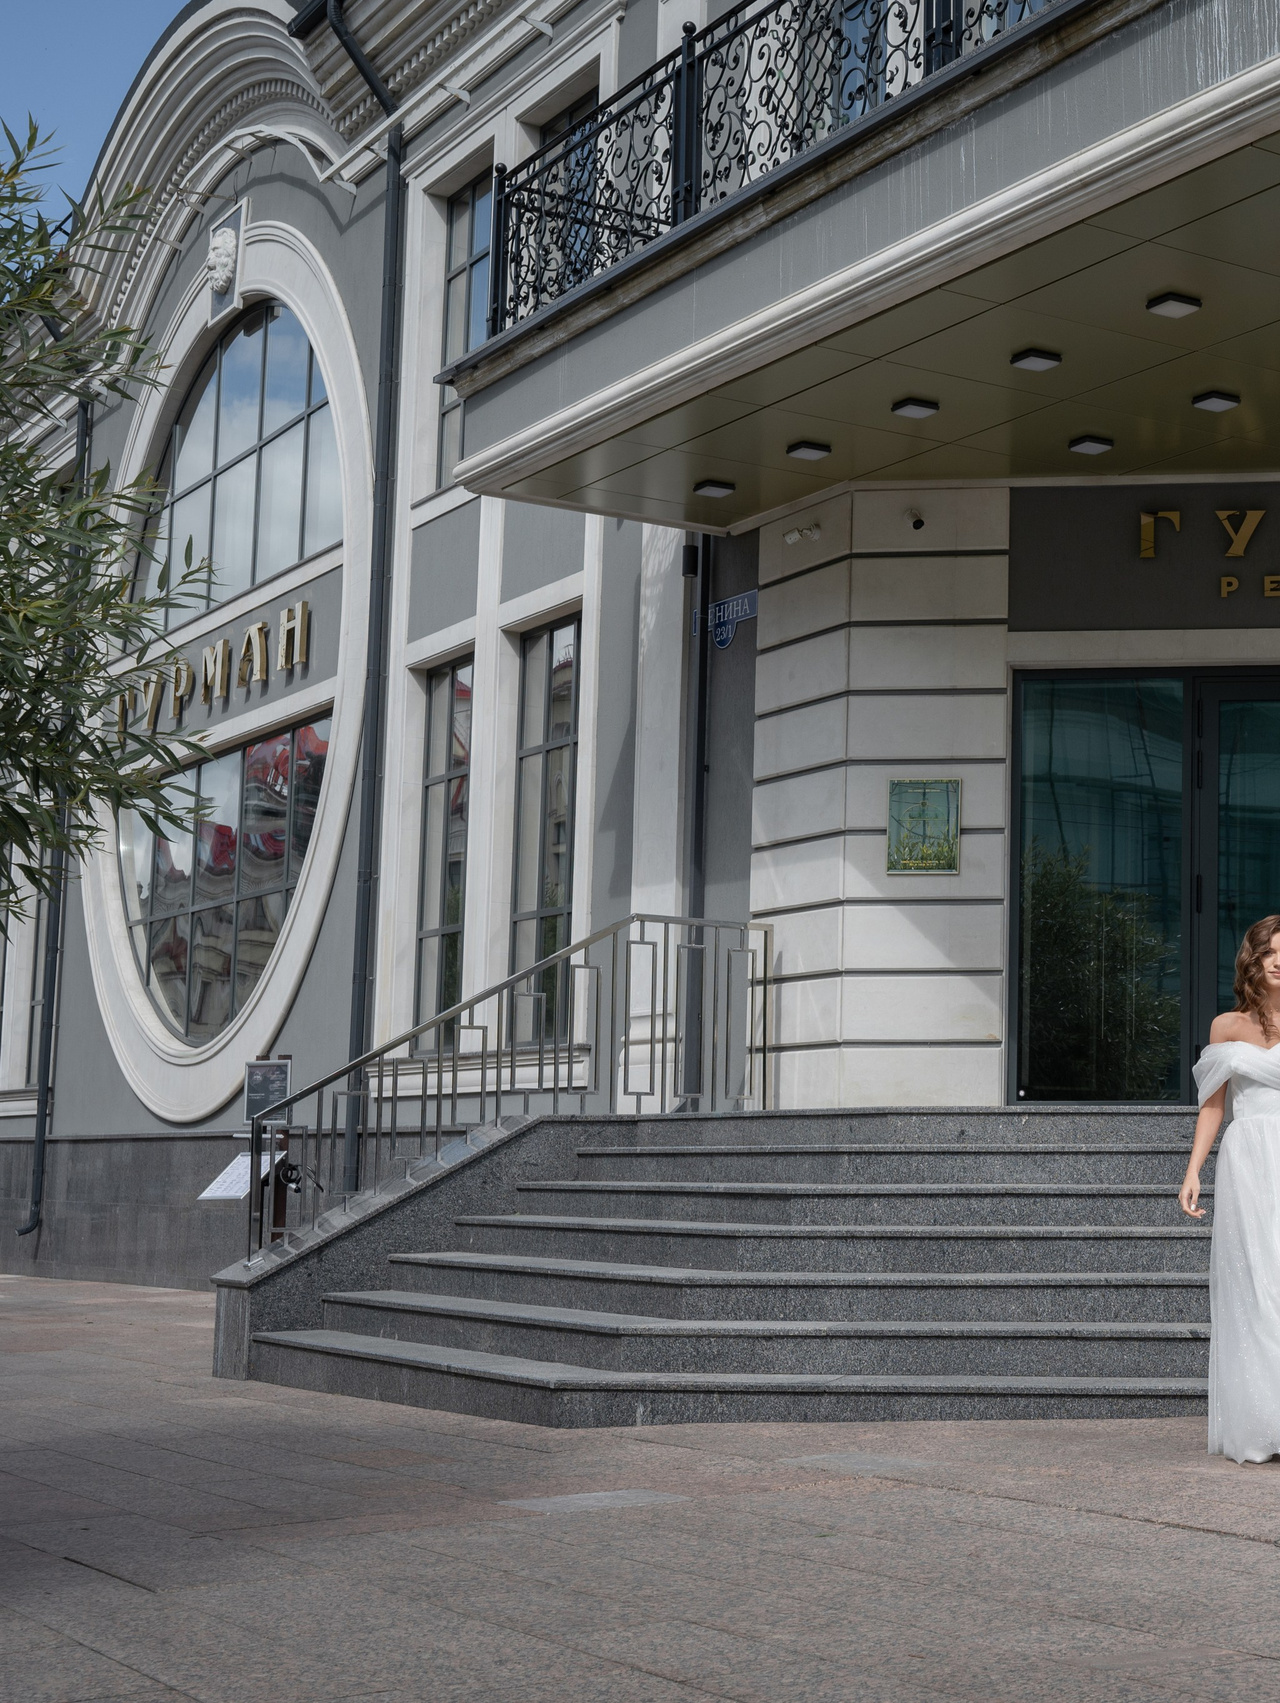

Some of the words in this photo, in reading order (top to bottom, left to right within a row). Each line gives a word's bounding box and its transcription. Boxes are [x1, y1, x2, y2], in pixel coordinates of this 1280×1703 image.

[708, 598, 750, 626] ЕНИНА
[715, 625, 732, 641] 23/1
[116, 600, 309, 742] ГУРМАН
